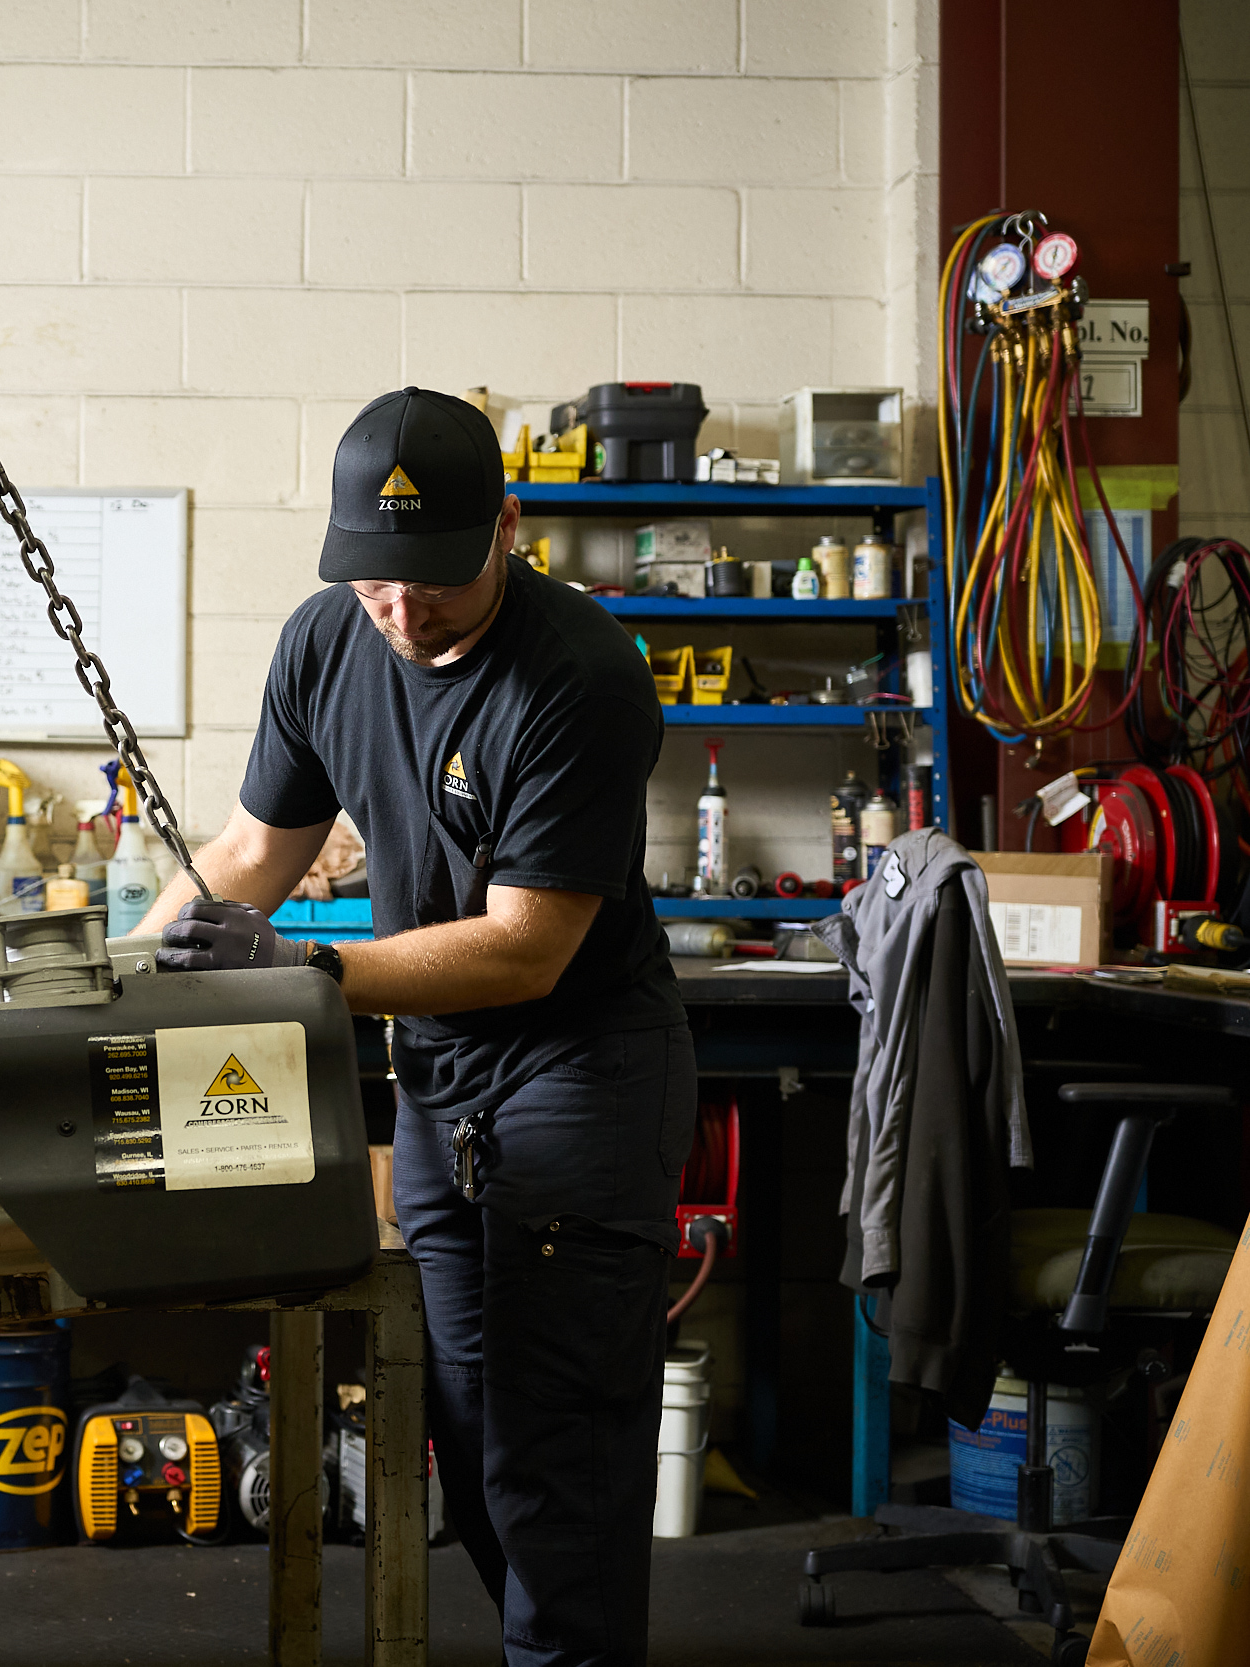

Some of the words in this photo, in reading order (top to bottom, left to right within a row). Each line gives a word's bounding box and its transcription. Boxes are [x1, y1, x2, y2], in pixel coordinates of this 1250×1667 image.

[1078, 320, 1102, 343] ol.
[1110, 320, 1148, 343] No.
[379, 499, 421, 511] ZORN
[443, 774, 469, 792] ORN
[248, 932, 260, 960] ULINE
[199, 1097, 269, 1117] ZORN
[206, 1146, 233, 1154] SERVICE
[268, 1142, 298, 1150] RENTALS
[981, 1411, 1028, 1431] -Plus
